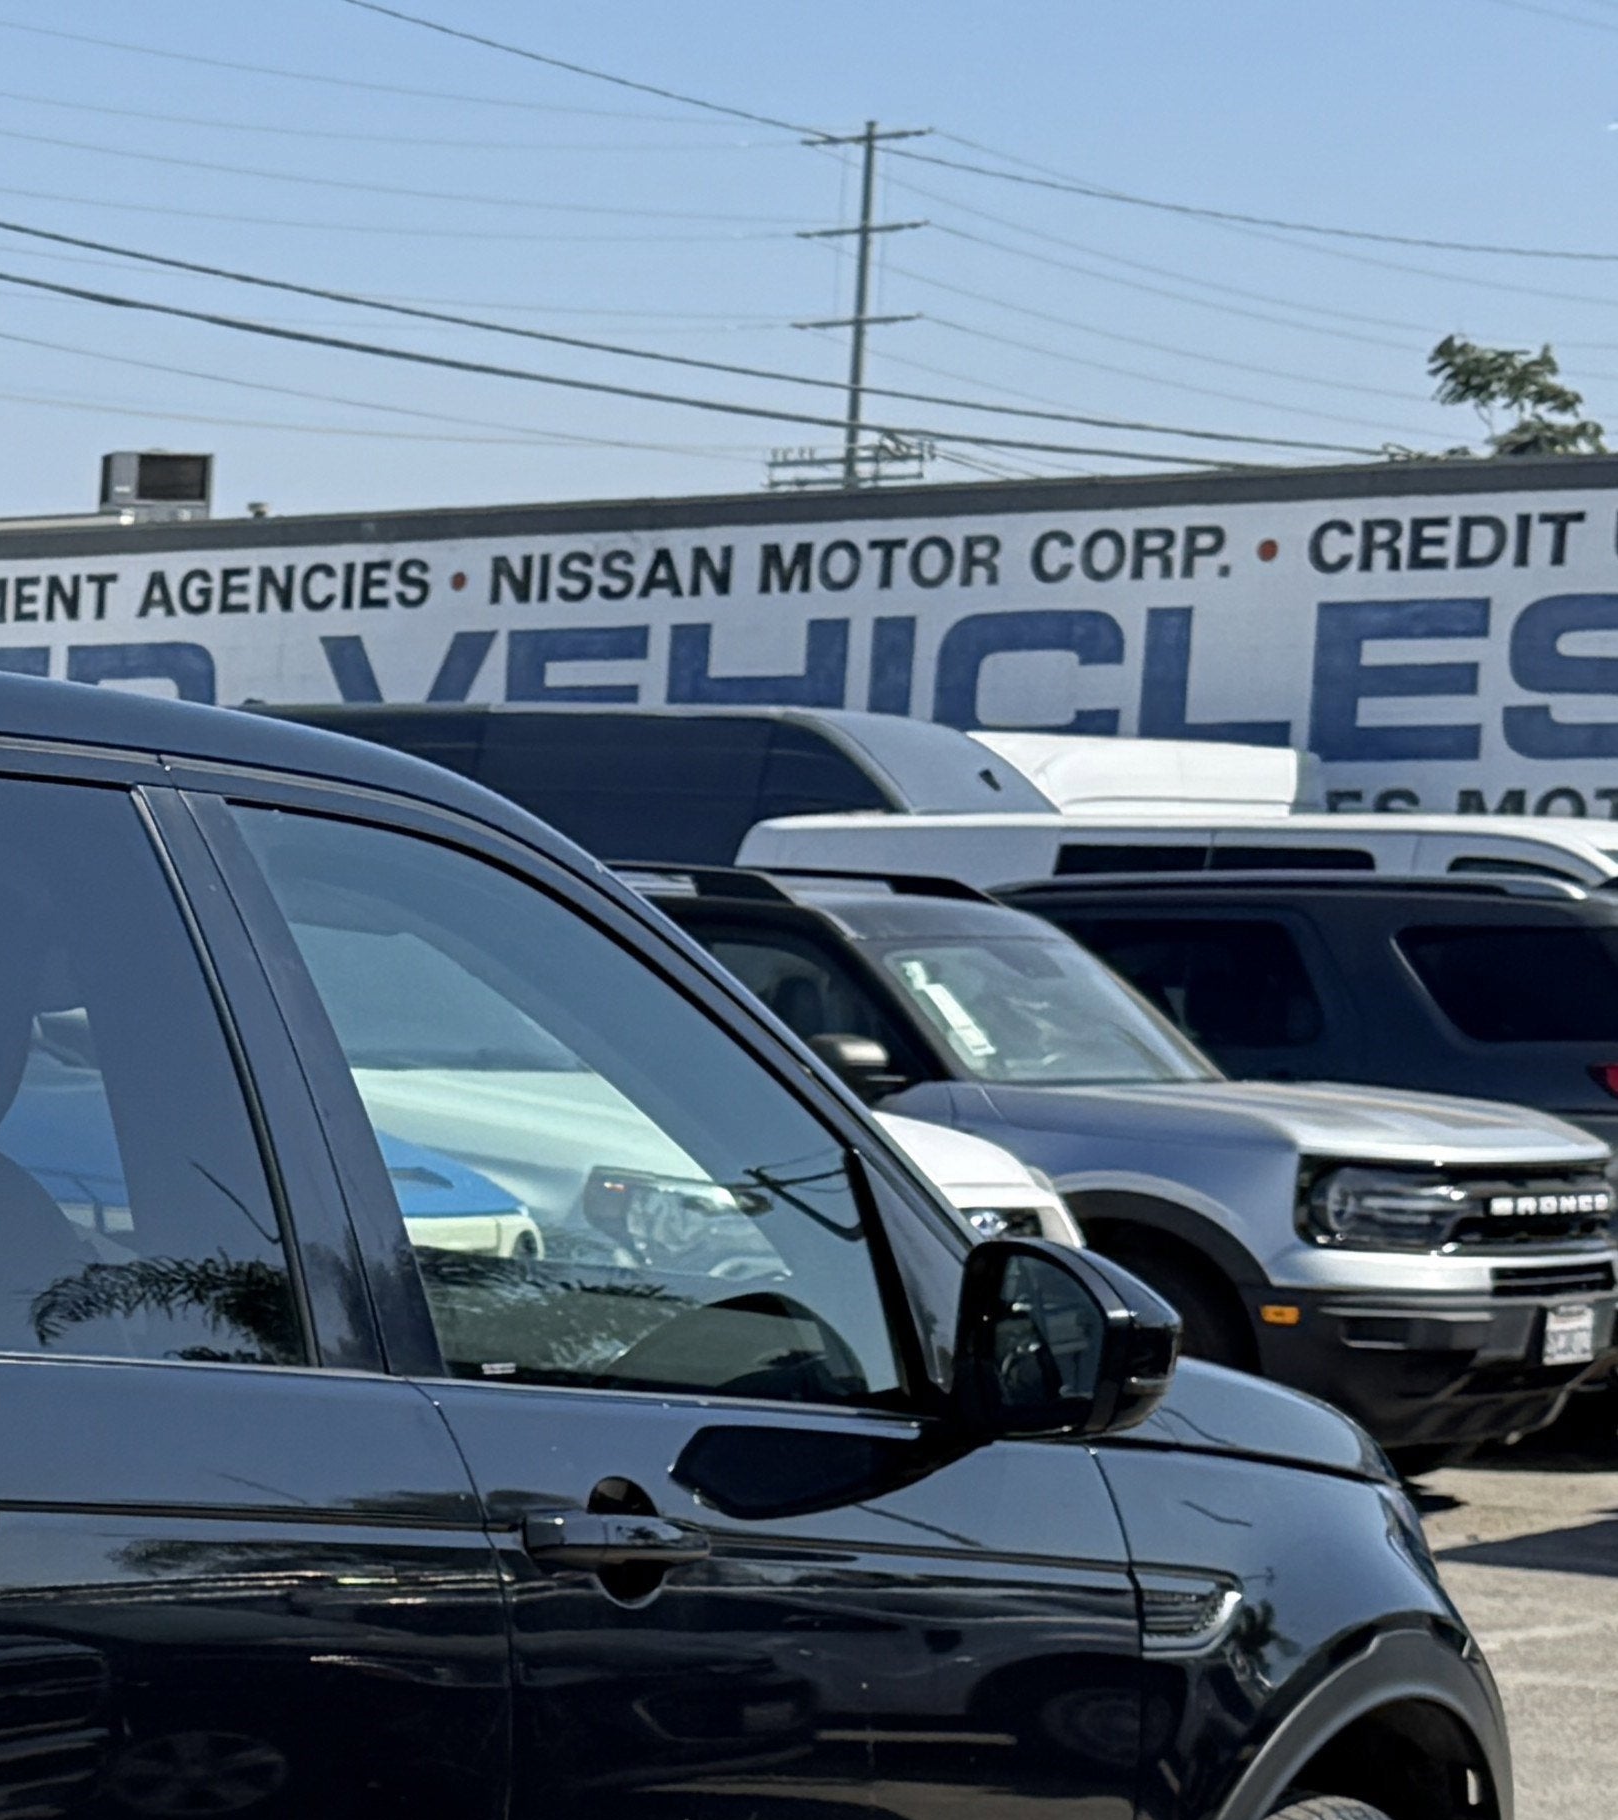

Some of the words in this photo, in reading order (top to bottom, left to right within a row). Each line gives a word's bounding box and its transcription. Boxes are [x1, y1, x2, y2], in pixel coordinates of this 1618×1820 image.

[137, 558, 431, 617] AGENCIES
[490, 545, 734, 603] NISSAN
[759, 535, 1001, 594] MOTOR
[1030, 525, 1230, 584] CORP.
[1308, 511, 1586, 572] CREDIT
